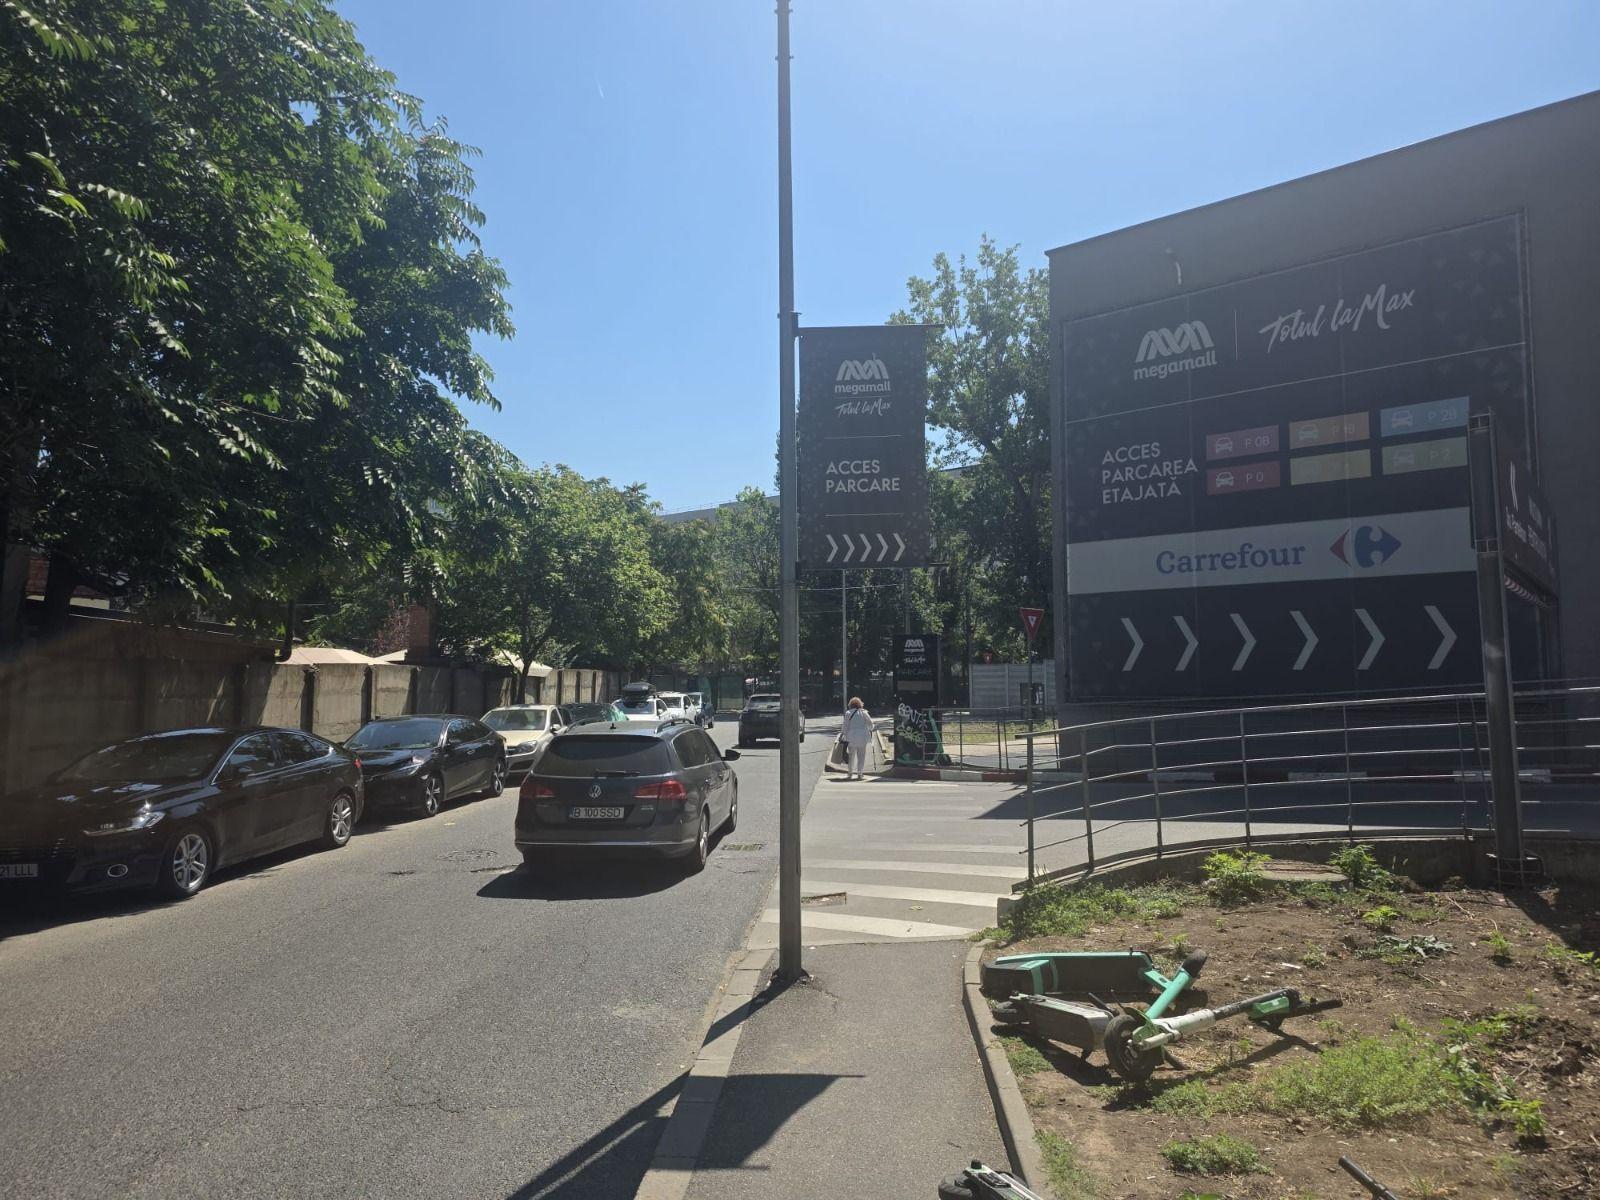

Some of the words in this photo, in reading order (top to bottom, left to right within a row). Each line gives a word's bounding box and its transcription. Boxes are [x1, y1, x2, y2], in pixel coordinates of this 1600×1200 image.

[1133, 351, 1217, 381] megamall
[834, 381, 891, 395] megamall
[1102, 442, 1161, 465] ACCES
[826, 459, 881, 475] ACCES
[1102, 458, 1198, 485] PARCAREA
[1246, 472, 1254, 484] P
[826, 477, 900, 493] PARCARE
[1102, 475, 1181, 505] ETAJATĂ
[1156, 542, 1305, 574] Carrefour
